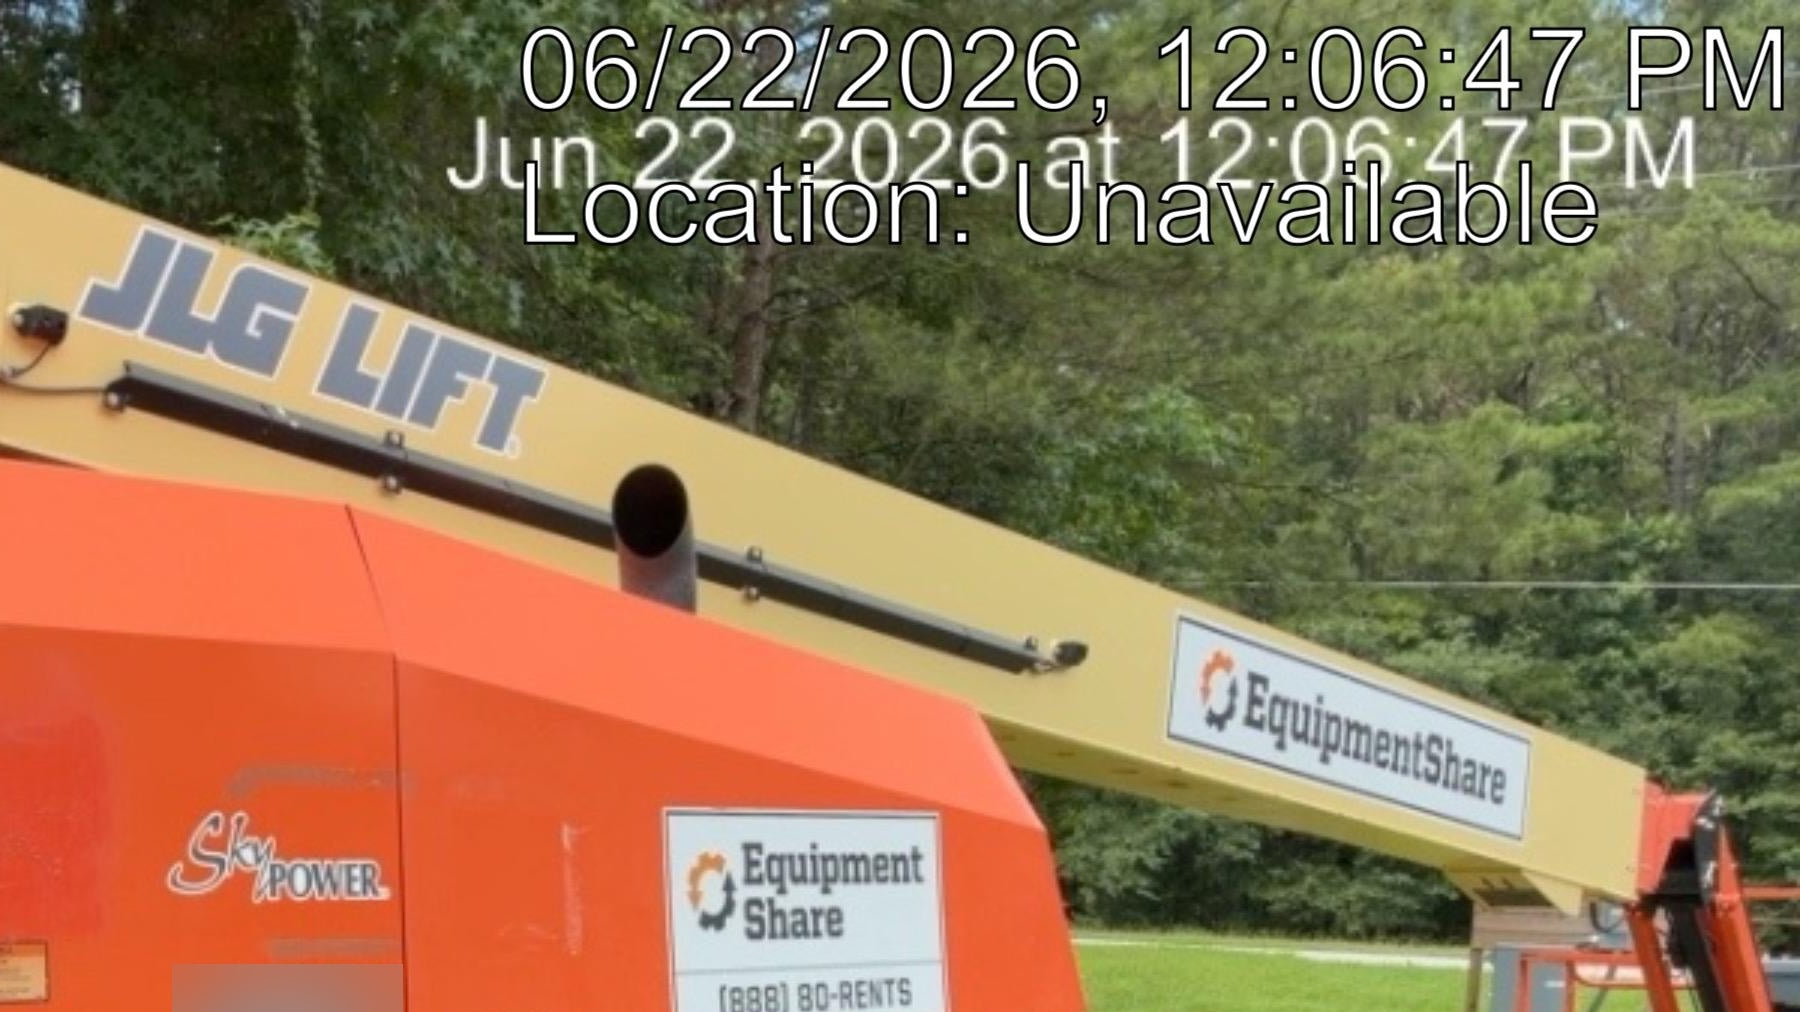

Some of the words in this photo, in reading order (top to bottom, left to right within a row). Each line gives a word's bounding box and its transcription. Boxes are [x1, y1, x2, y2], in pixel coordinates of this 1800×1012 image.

[77, 225, 312, 381] JLG
[313, 301, 547, 456] LIFT
[1243, 671, 1507, 804] EquipmentShare
[167, 811, 275, 903] Sky
[268, 860, 381, 900] POWER
[741, 842, 925, 895] Equipment
[743, 897, 844, 940] Share
[797, 977, 913, 1012] 80-RENTS
